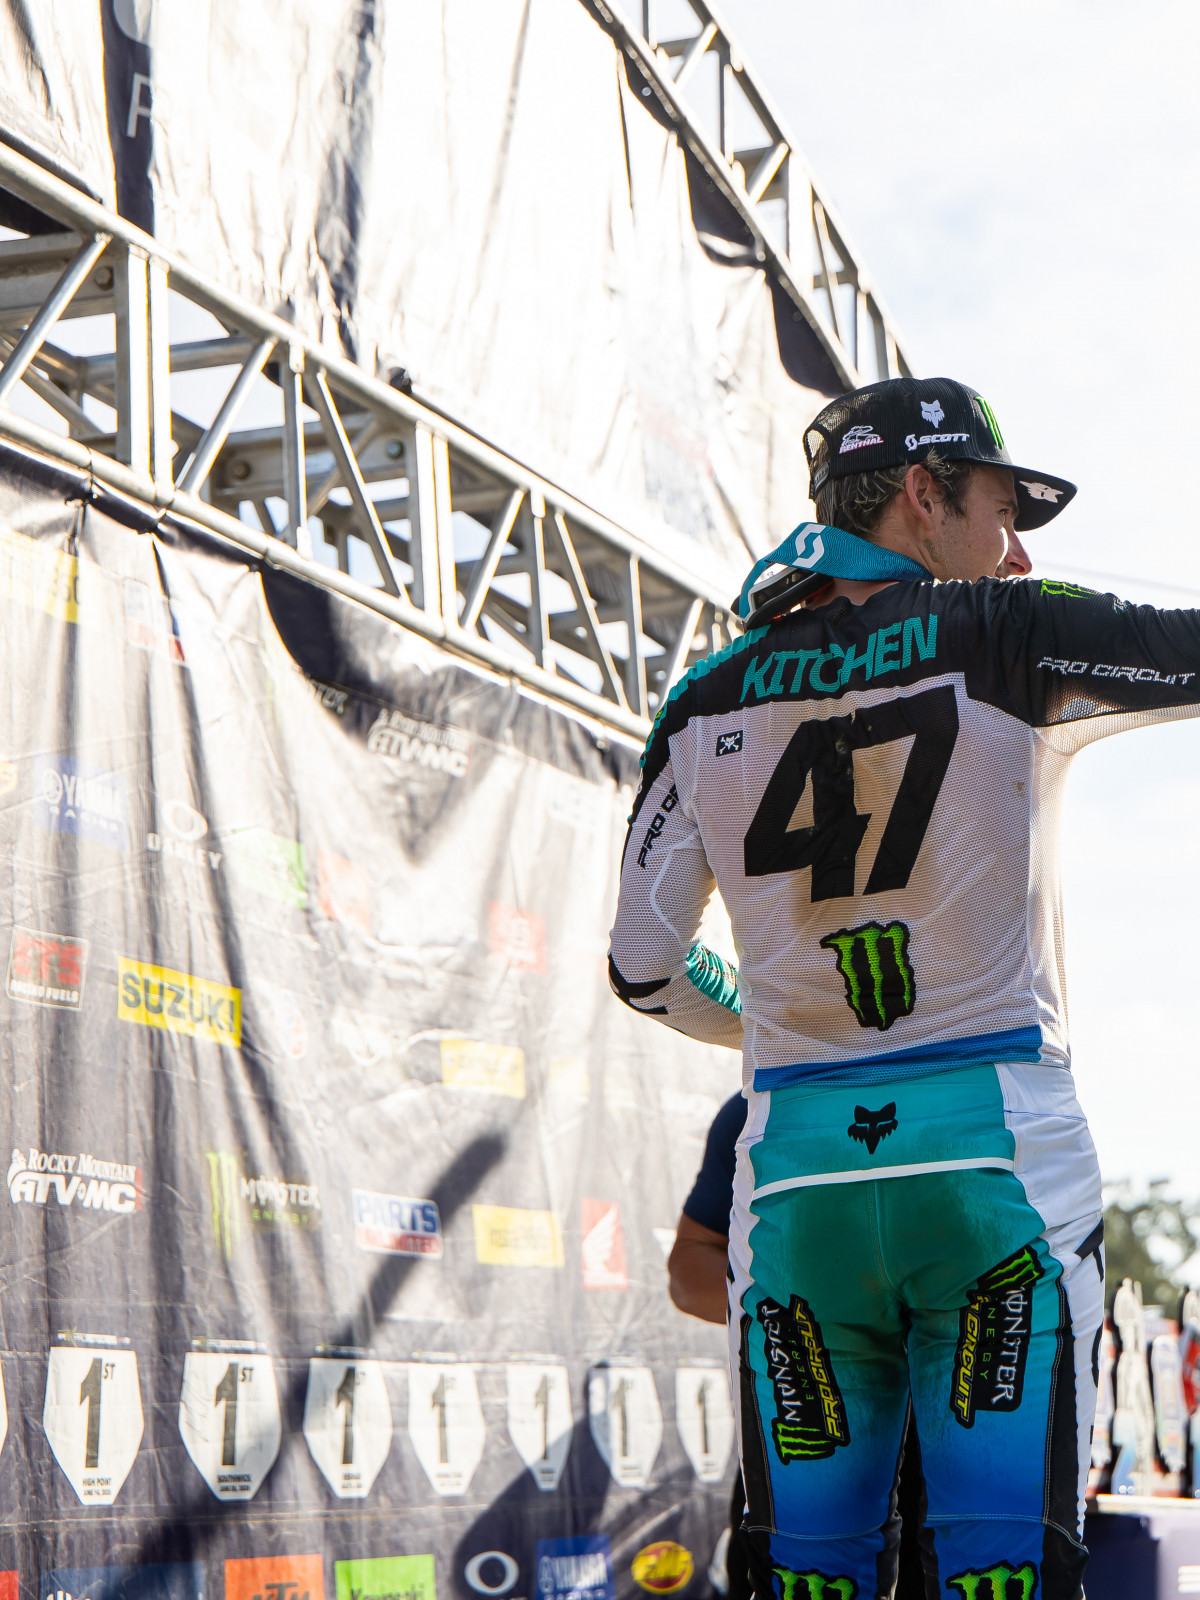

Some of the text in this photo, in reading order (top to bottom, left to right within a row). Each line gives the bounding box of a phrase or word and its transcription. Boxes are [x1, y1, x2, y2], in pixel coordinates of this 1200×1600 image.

[838, 436, 885, 455] RENTHAL
[917, 433, 970, 446] SCOTT
[740, 613, 938, 703] KITCHEN
[1037, 656, 1196, 685] PRO CIRCUIT
[743, 684, 960, 903] 47
[122, 971, 235, 1034] SUZUKI
[28, 1147, 137, 1183] ROCKY MOUNTAIN
[240, 1174, 321, 1209] MONSTER
[357, 1195, 437, 1233] PARTS
[818, 1385, 844, 1441] PRO
